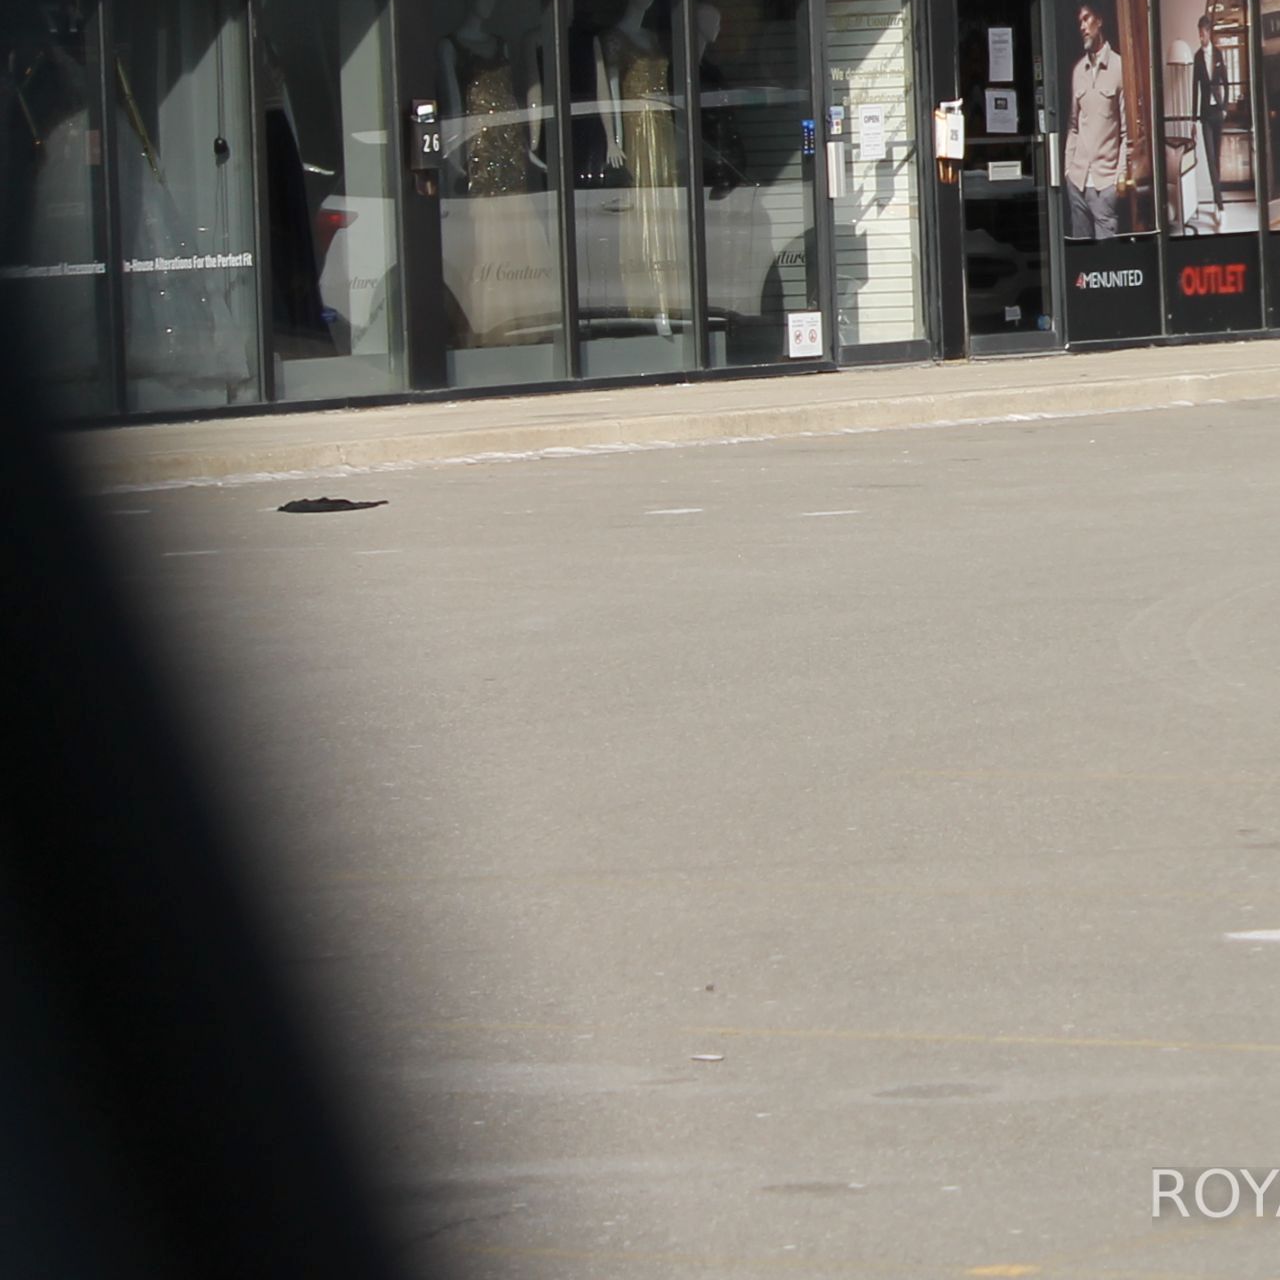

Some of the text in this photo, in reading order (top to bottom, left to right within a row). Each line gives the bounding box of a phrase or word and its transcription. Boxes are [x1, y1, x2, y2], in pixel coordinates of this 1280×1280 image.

[423, 134, 440, 152] 26
[1076, 269, 1143, 289] 4MENUNITED
[1180, 265, 1246, 296] OUTLET
